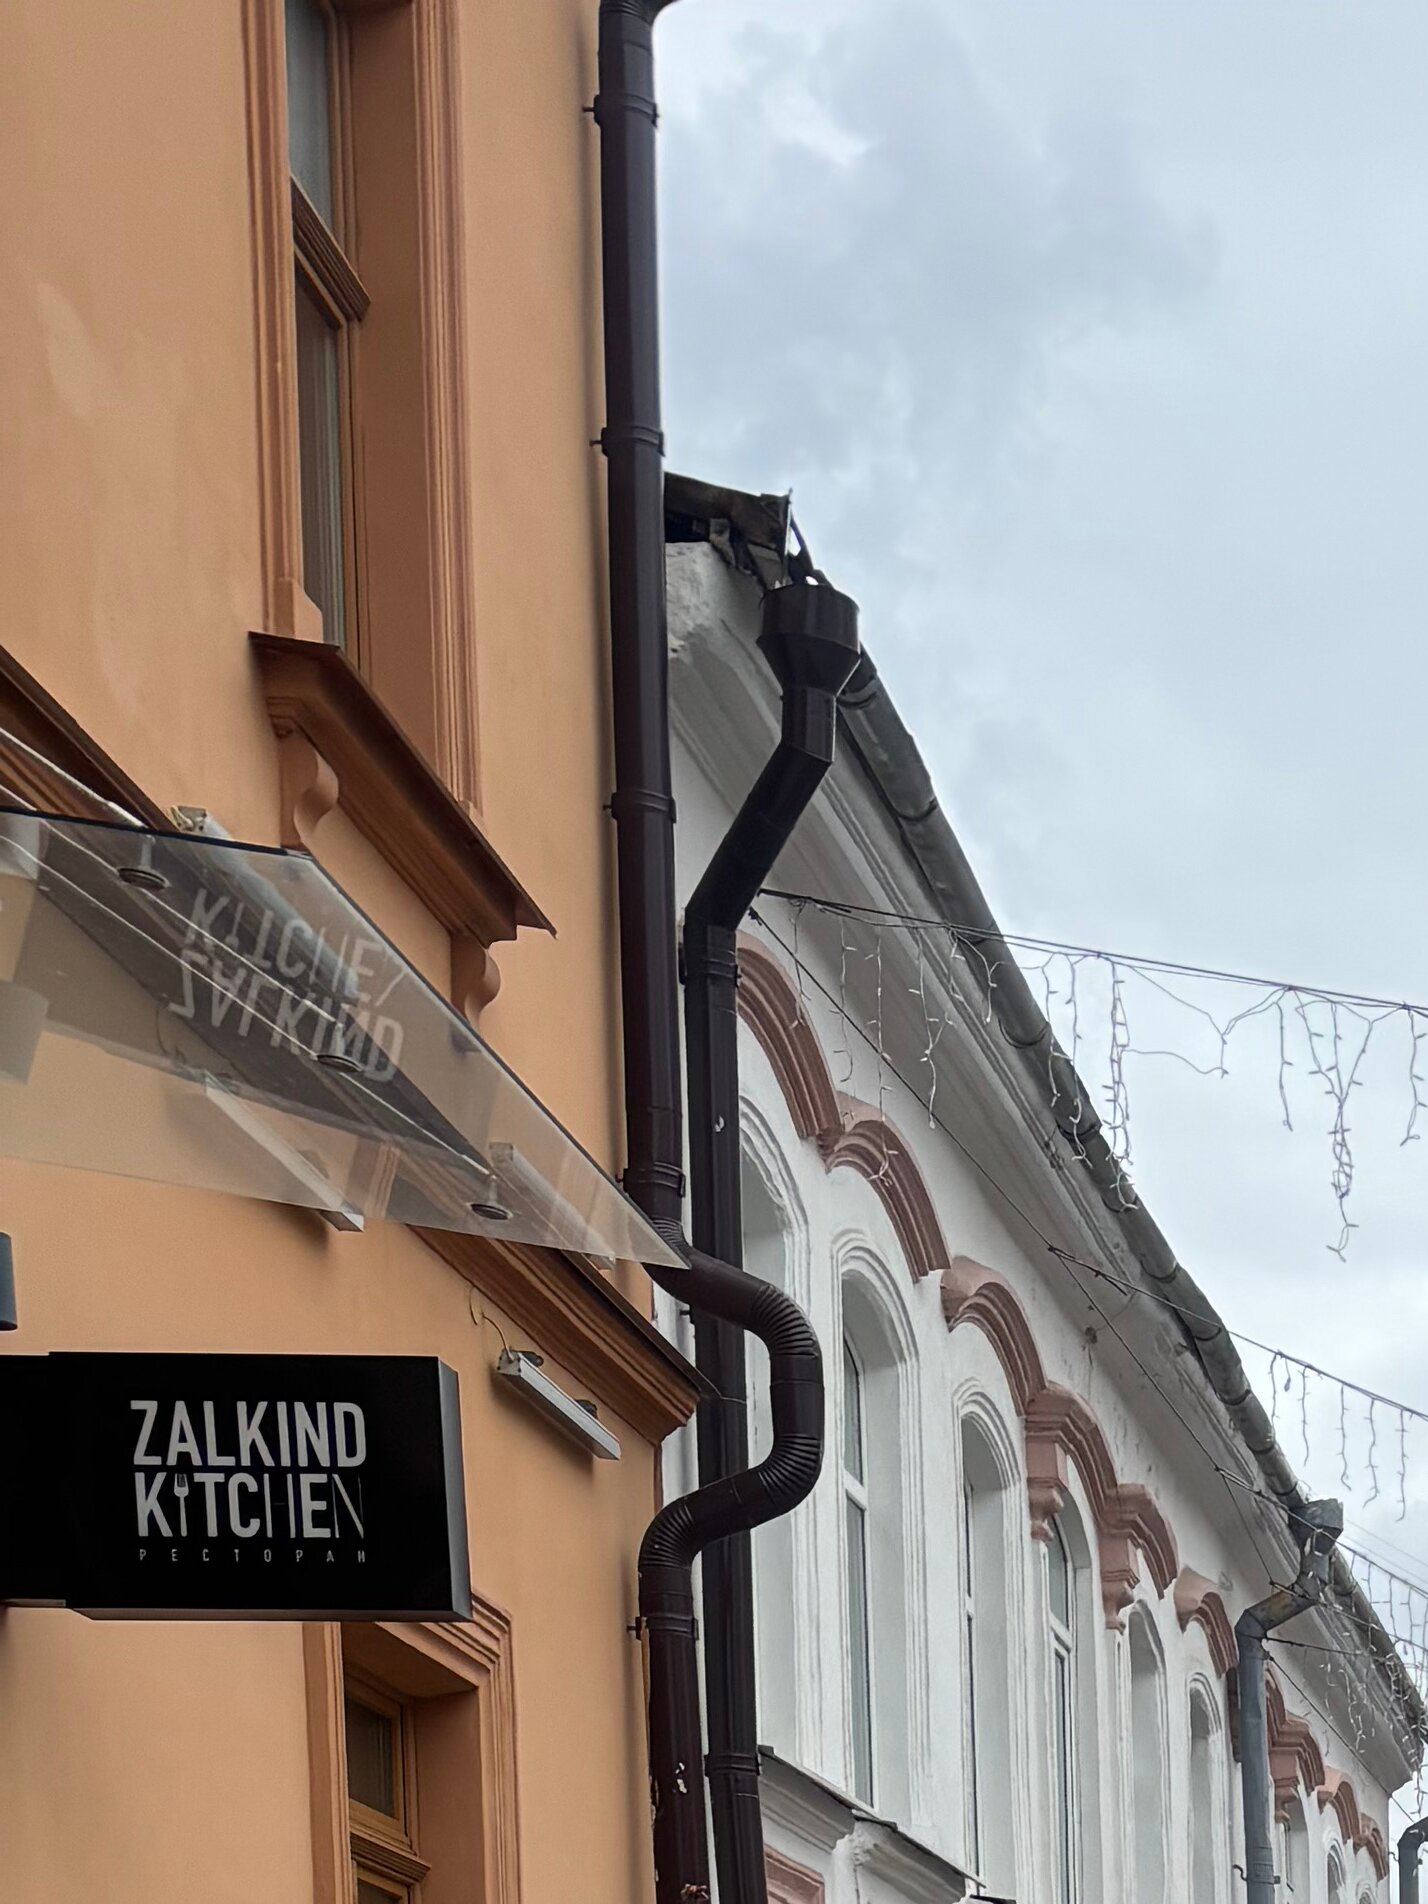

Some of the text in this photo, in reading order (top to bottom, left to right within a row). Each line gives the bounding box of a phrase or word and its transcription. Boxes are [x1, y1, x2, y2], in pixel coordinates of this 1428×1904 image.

[130, 1400, 367, 1467] ZALKIND
[134, 1472, 365, 1539] KITCHEN
[139, 1549, 366, 1562] РЕСТОРАН
